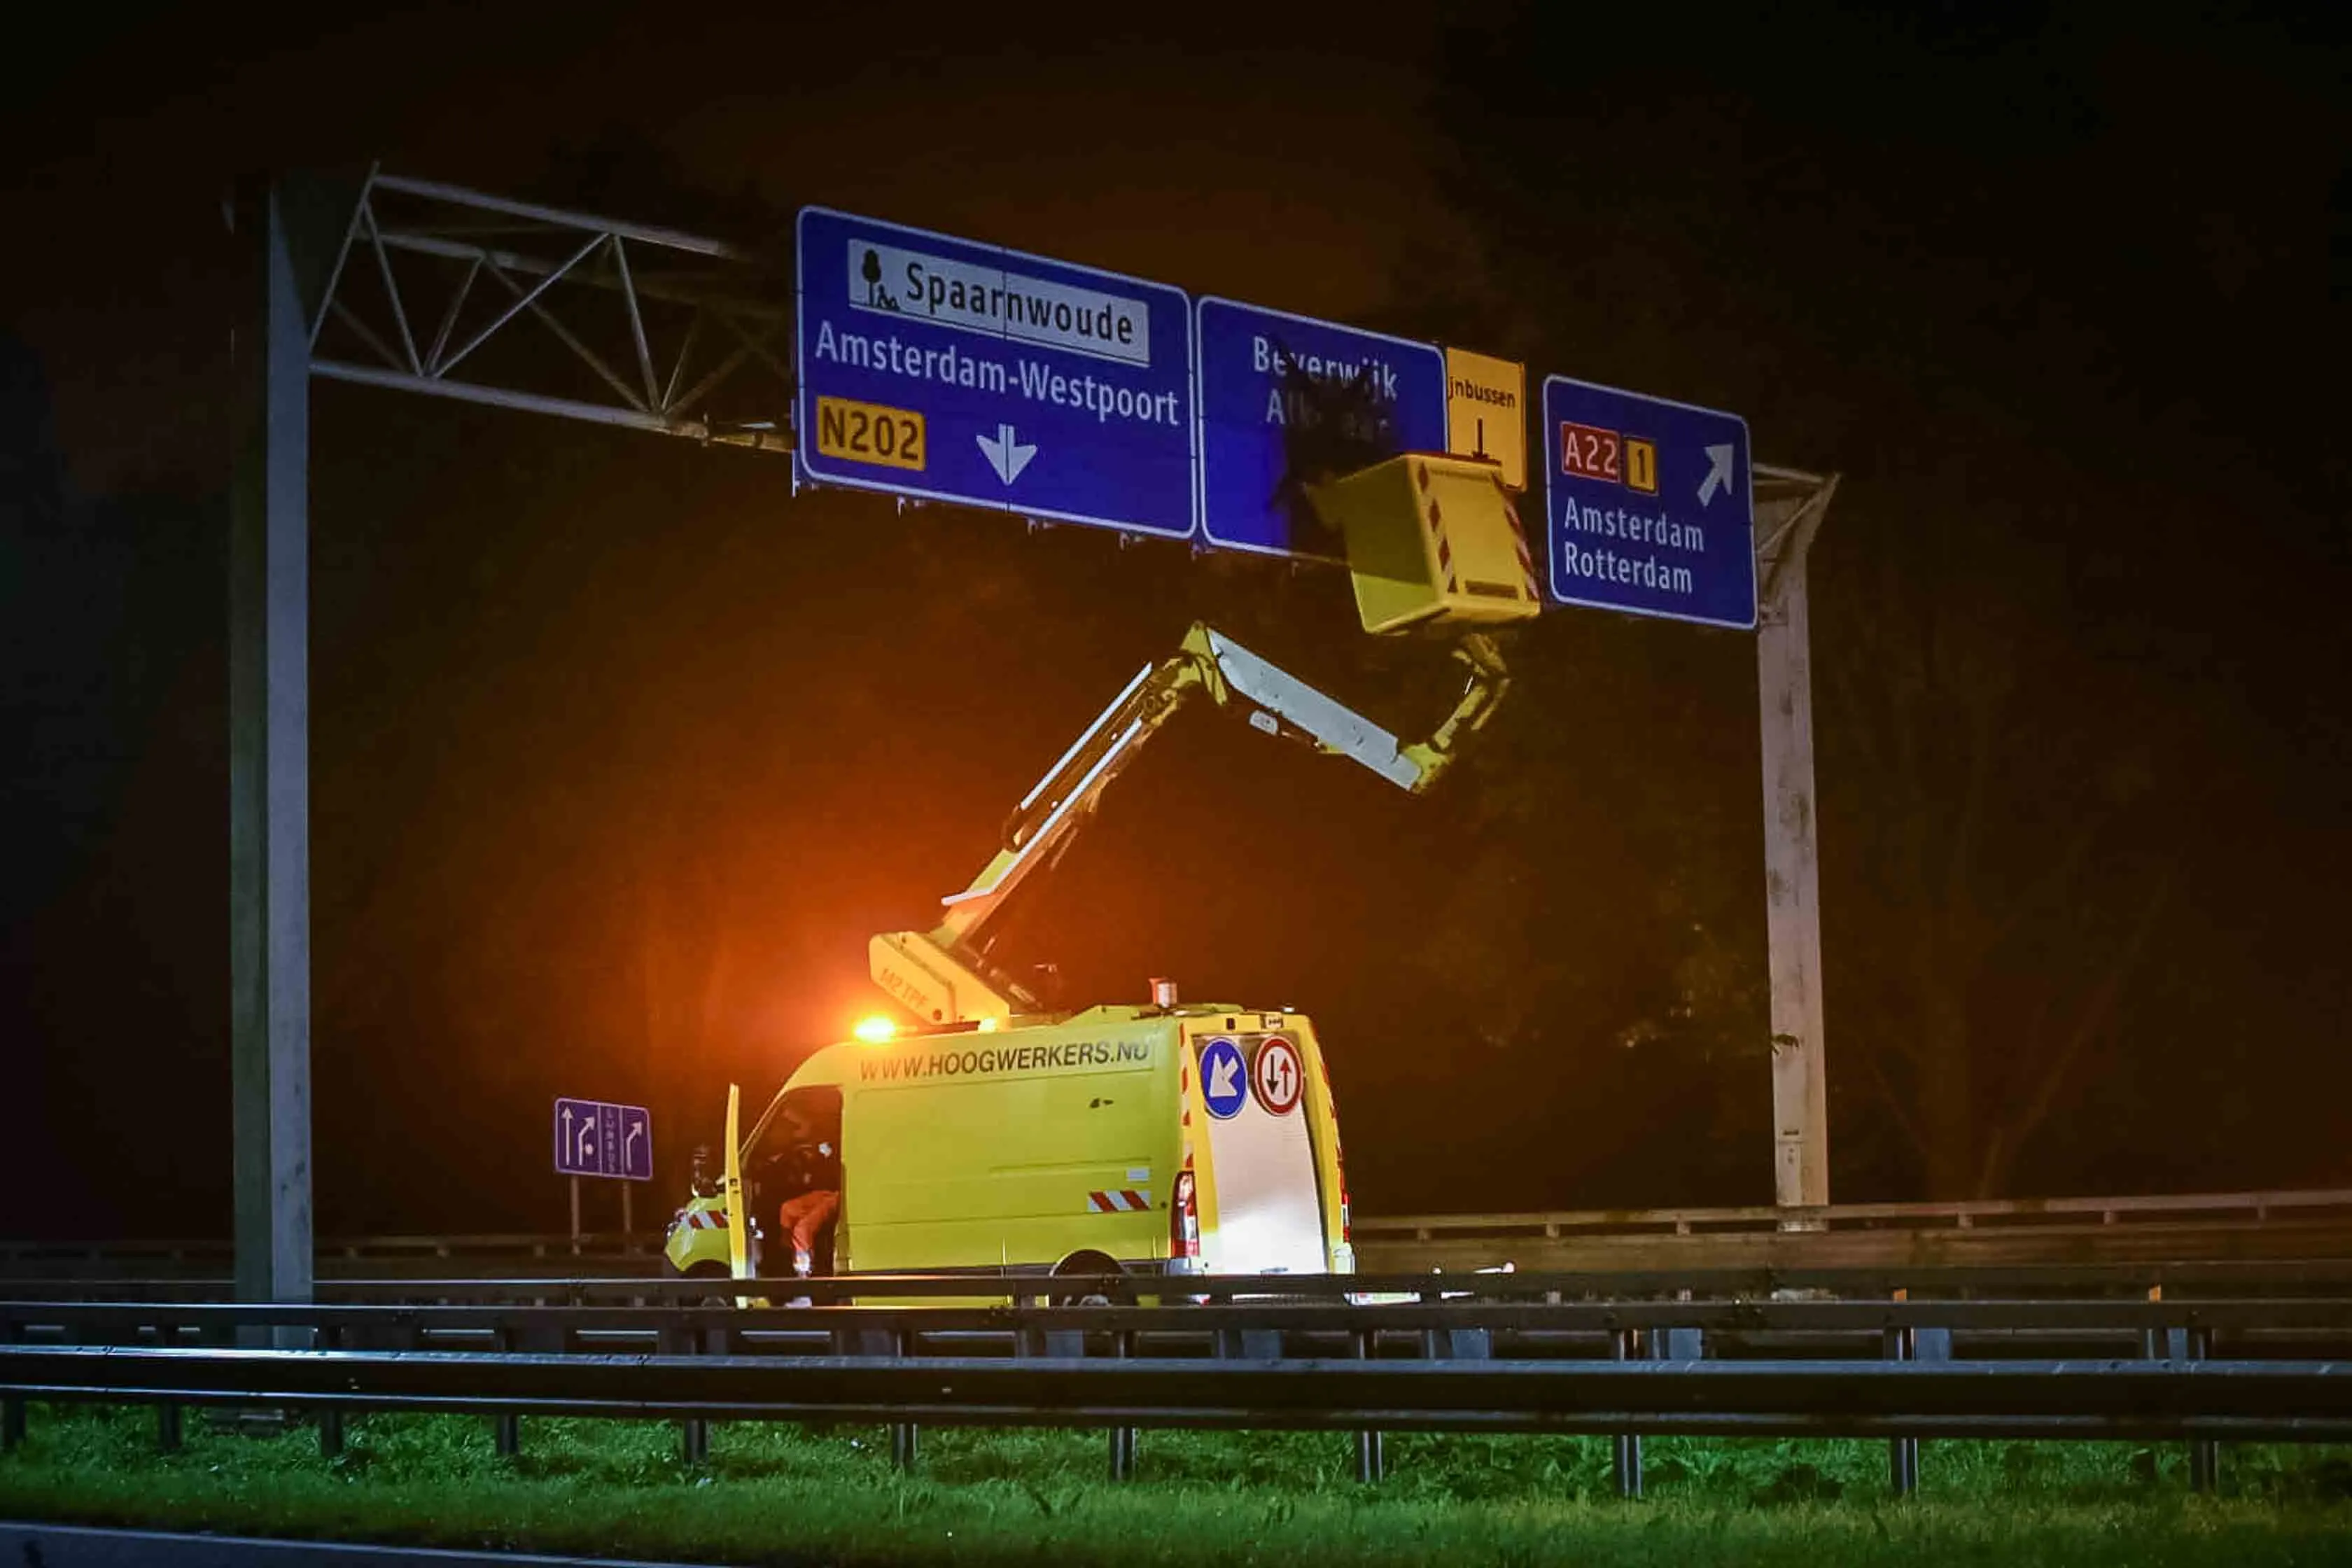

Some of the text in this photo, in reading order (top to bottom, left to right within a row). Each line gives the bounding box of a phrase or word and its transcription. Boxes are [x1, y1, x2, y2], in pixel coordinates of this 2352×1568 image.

[906, 263, 1133, 346] Spaarnwoude
[816, 320, 1180, 426] Amsterdam-Westpoort
[1448, 376, 1516, 409] jnbussen
[821, 405, 919, 461] N202
[1564, 431, 1618, 475] A22
[1564, 496, 1704, 552] Amsterdam
[1564, 541, 1693, 594] Rotterdam
